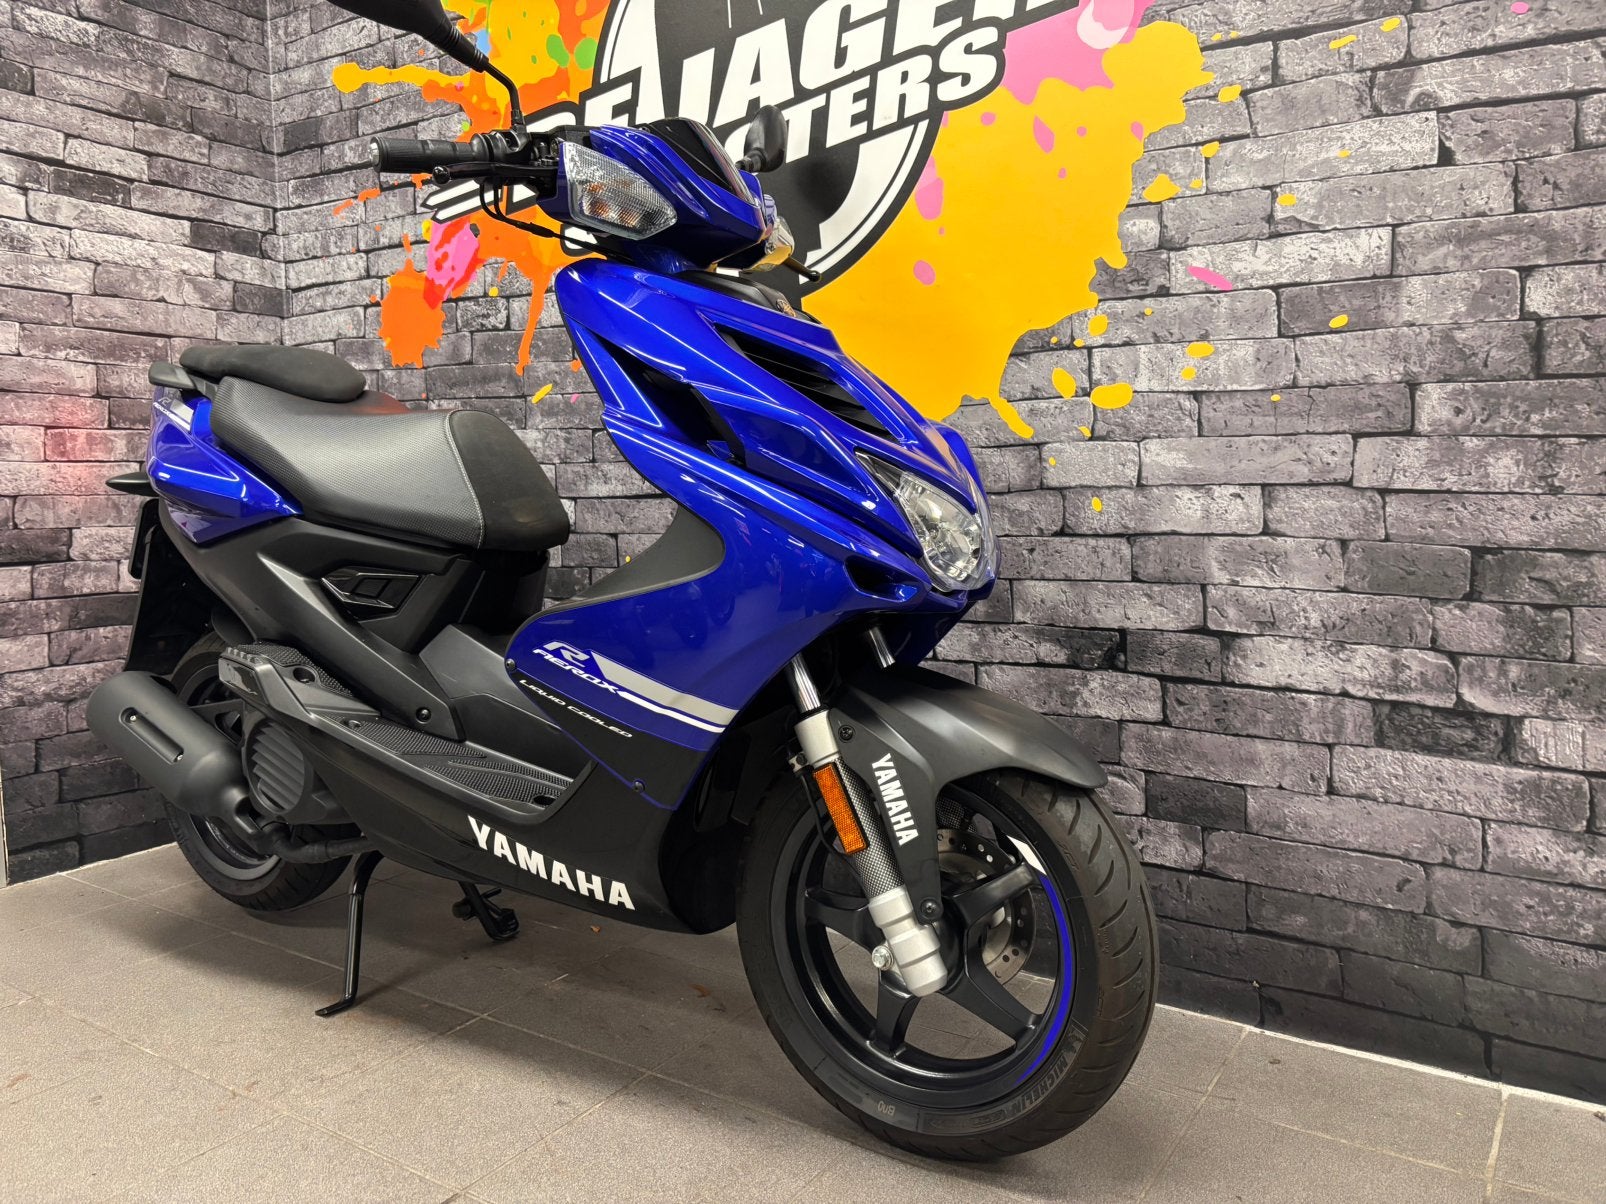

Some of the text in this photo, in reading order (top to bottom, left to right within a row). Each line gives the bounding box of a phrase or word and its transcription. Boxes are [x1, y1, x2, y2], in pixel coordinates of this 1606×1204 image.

[532, 648, 619, 694] AEROX
[519, 679, 633, 738] LIQUID COOLED
[871, 752, 919, 846] YAMAHA
[467, 814, 635, 911] YAMAHA
[1009, 1053, 1068, 1115] MICHELIN
